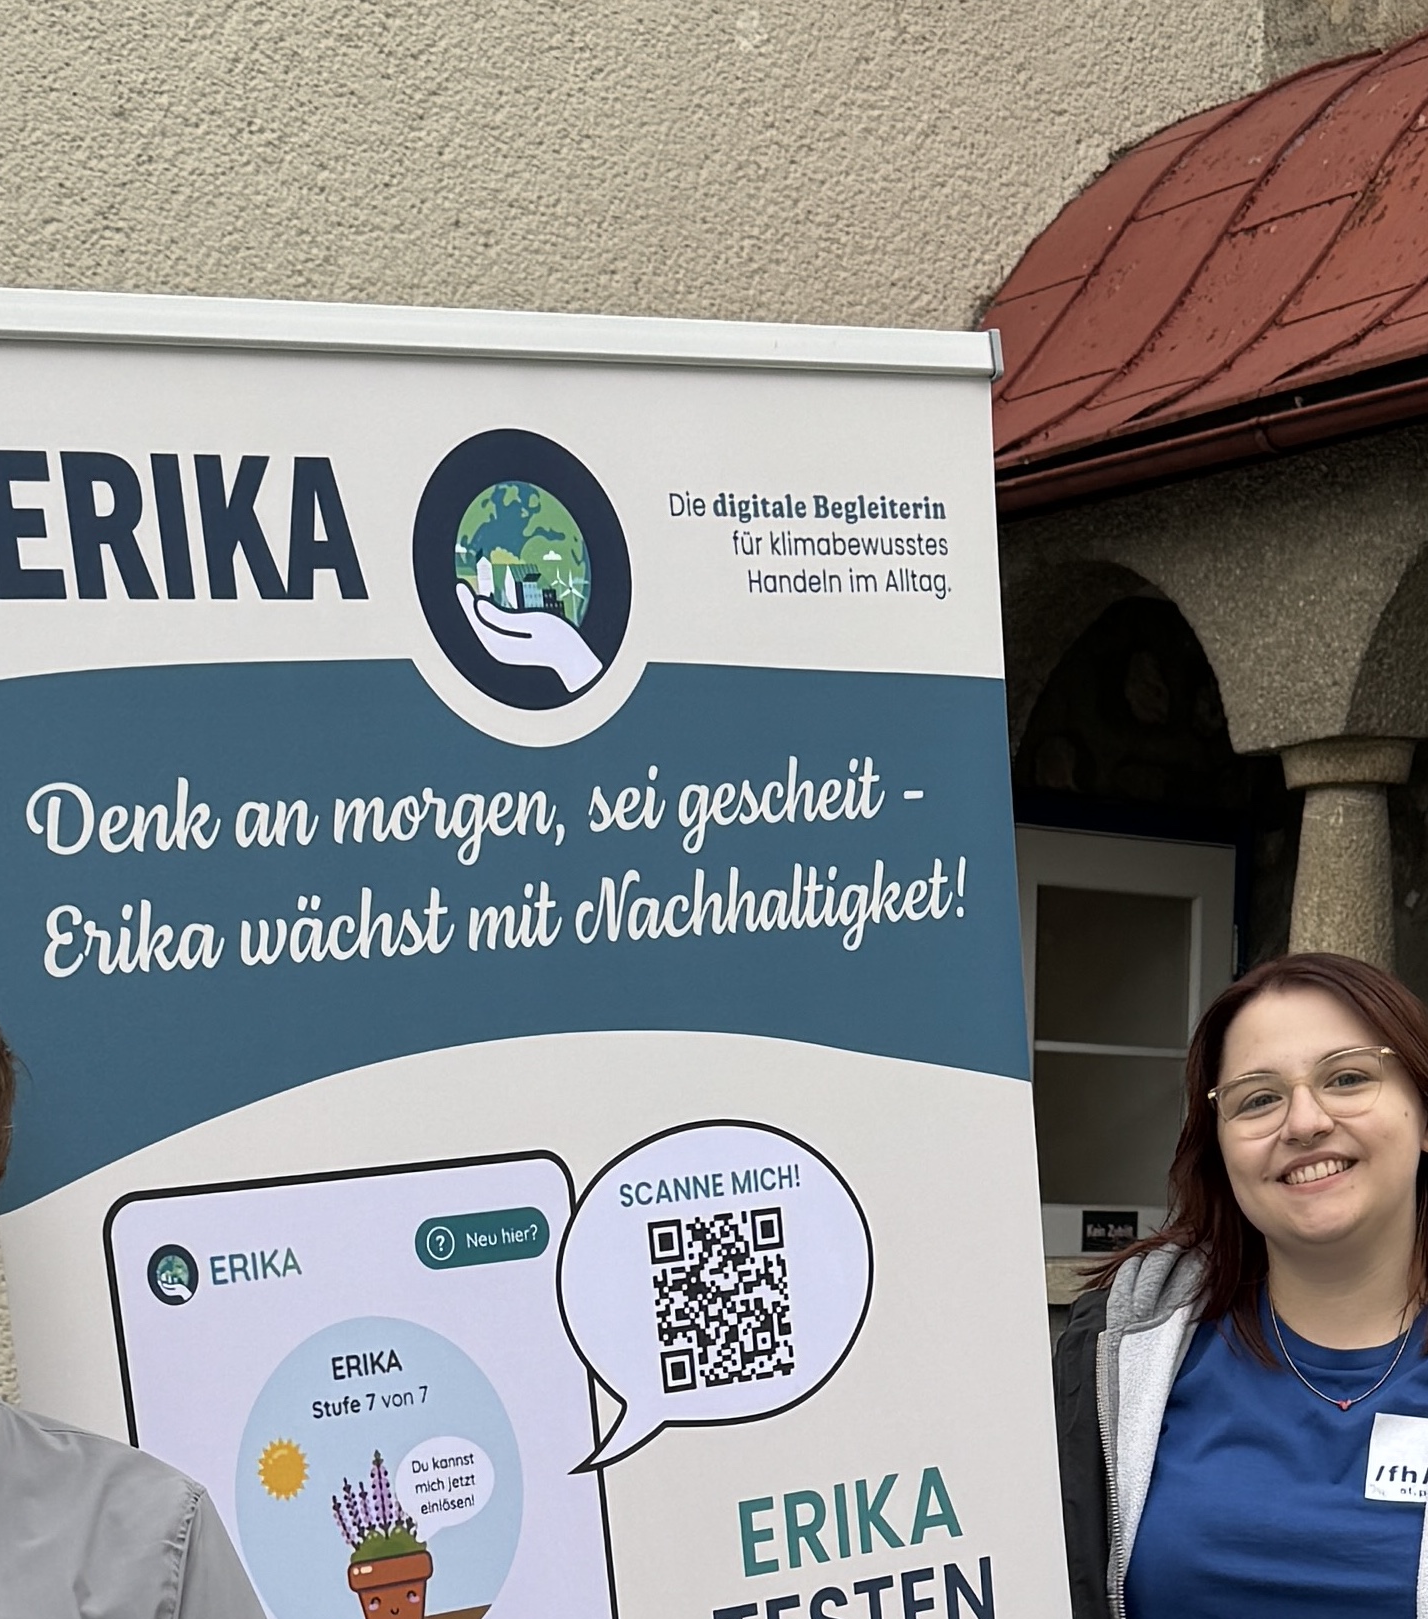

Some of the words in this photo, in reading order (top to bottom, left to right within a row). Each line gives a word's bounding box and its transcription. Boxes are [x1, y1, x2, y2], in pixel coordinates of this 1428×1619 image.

[669, 491, 706, 517] Die
[713, 492, 806, 523] digitale
[813, 494, 946, 524] Begleiterin
[732, 531, 762, 556] für
[769, 531, 949, 556] klimabewusstes
[748, 569, 842, 593] Handeln
[849, 568, 877, 593] im
[885, 568, 952, 600] Alltag.
[25, 776, 220, 856] Denk
[234, 802, 318, 847] an
[333, 790, 565, 865] morgen,
[588, 766, 664, 834] sei
[677, 757, 885, 854] gescheit
[43, 883, 224, 980] Erika
[239, 878, 454, 969] wächst
[469, 883, 561, 955] mit
[574, 856, 967, 951] Nachhaltigket!
[619, 1174, 725, 1208] SCANNE
[731, 1165, 801, 1198] MICH!
[465, 1229, 498, 1249] Neu
[502, 1222, 540, 1245] hier?
[209, 1248, 302, 1286] ERIKA
[331, 1350, 403, 1381] ERIKA
[311, 1394, 362, 1420] Stufe
[366, 1393, 376, 1413] 7
[381, 1389, 414, 1409] von
[418, 1386, 429, 1404] 7
[412, 1460, 428, 1473] Du
[432, 1454, 474, 1470] kannst
[415, 1478, 444, 1494] mich
[448, 1474, 475, 1492] jetzt
[421, 1494, 474, 1514] einlösen!
[739, 1466, 962, 1577] ERIKA
